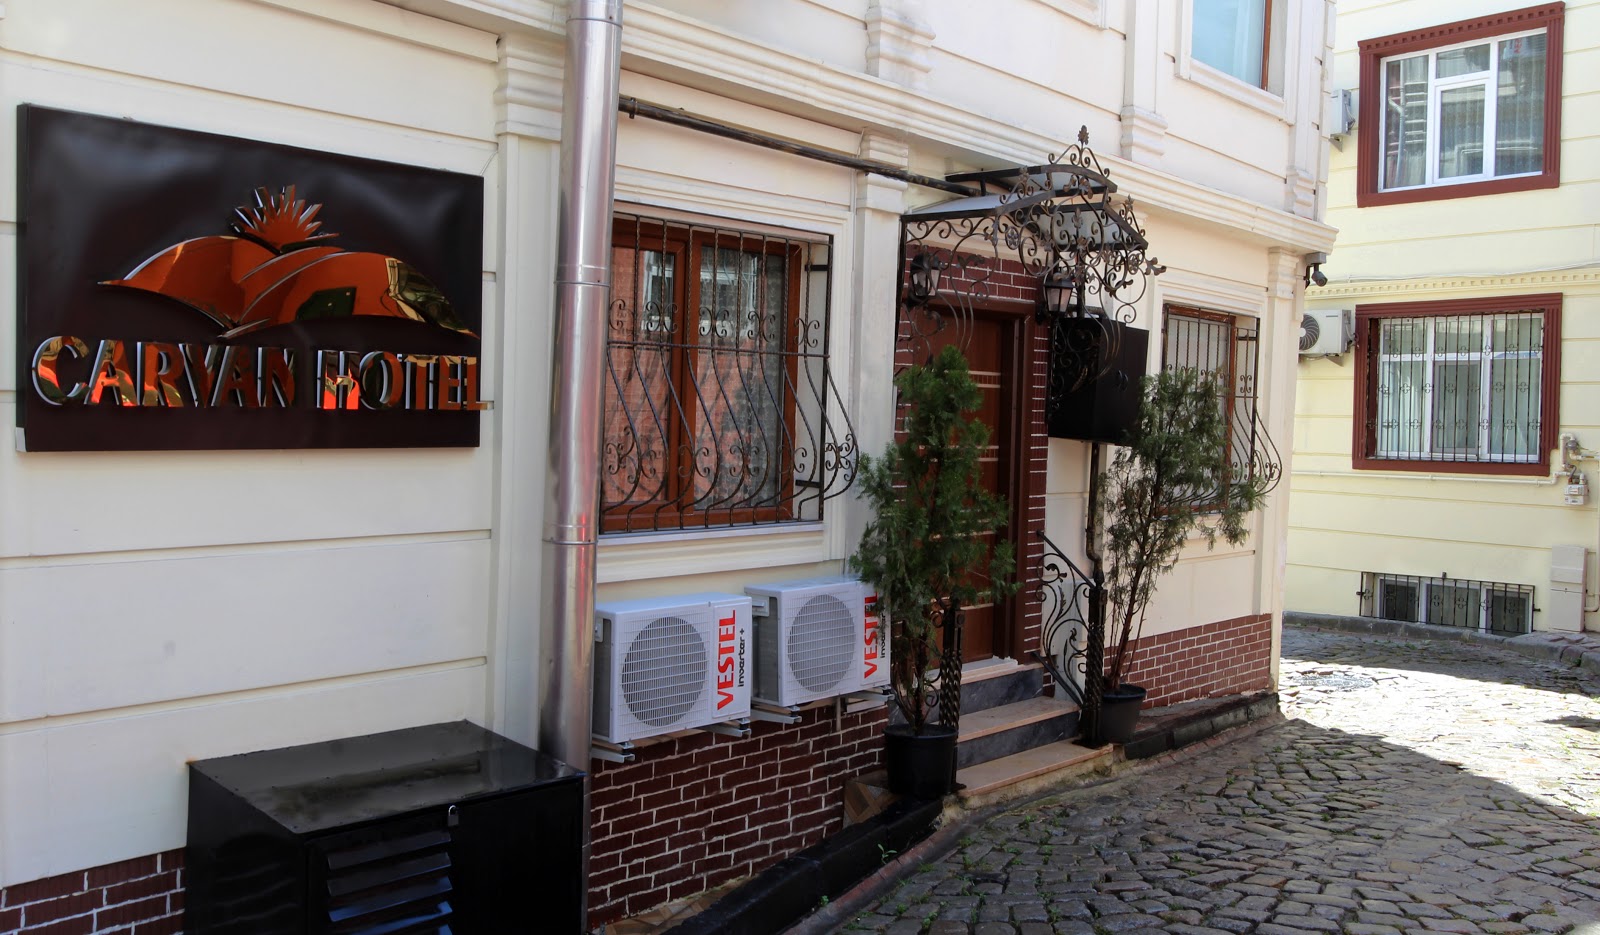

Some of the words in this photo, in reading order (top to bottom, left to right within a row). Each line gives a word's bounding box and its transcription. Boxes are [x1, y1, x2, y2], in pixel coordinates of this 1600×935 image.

[32, 335, 296, 407] CARVAN
[317, 350, 493, 410] HOTEL
[717, 609, 736, 711] VESTEL
[864, 592, 878, 679] VESTEL
